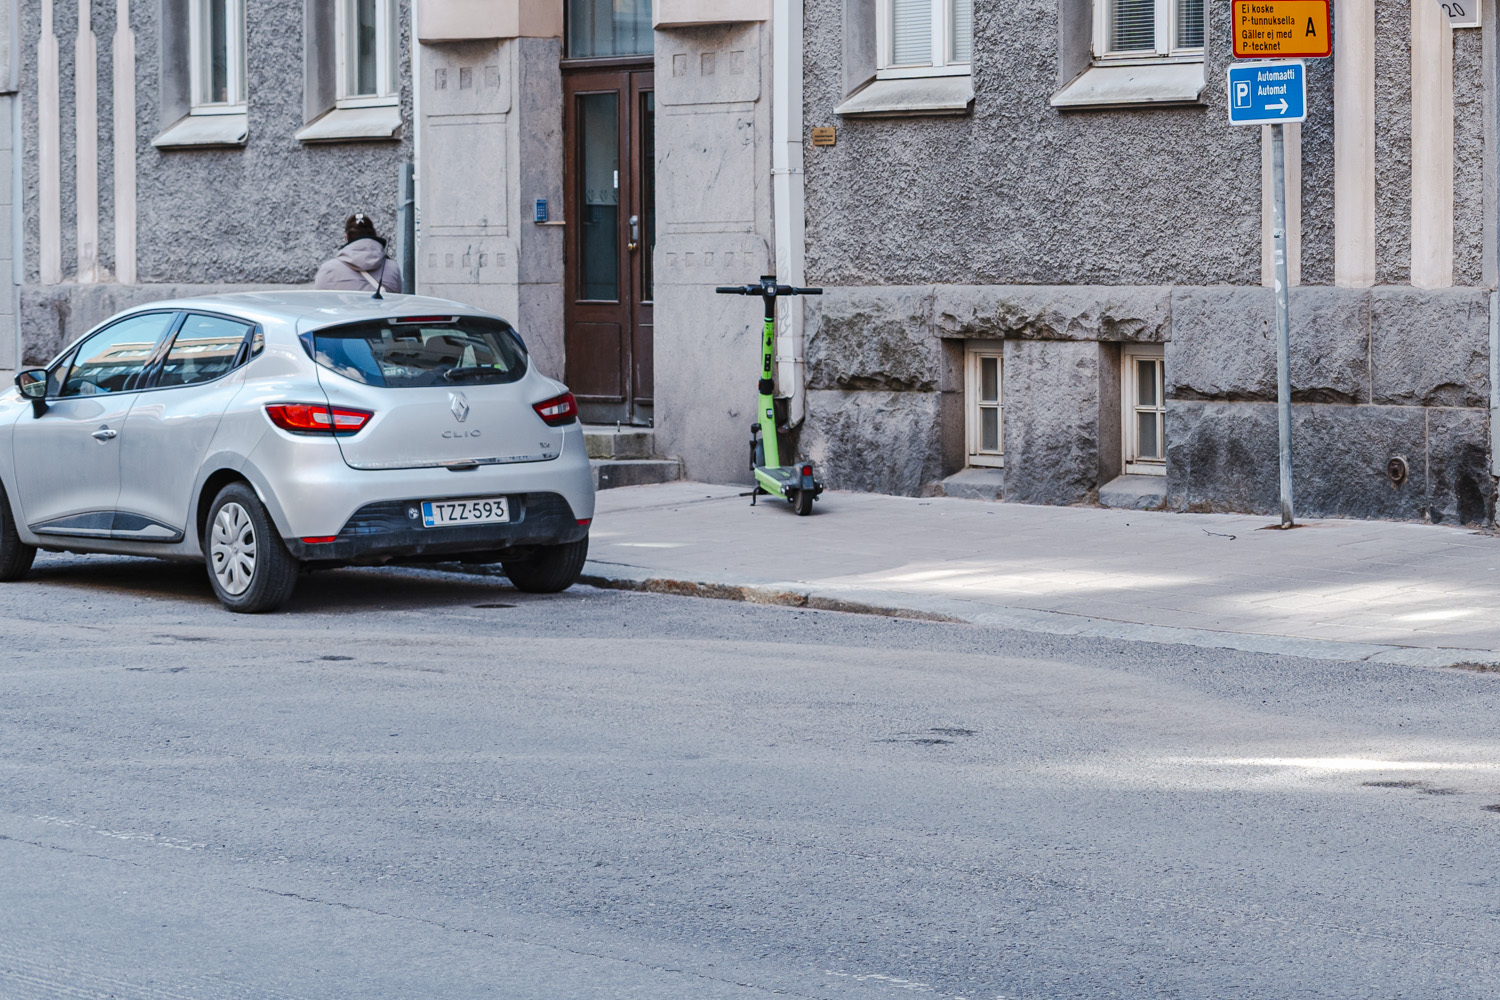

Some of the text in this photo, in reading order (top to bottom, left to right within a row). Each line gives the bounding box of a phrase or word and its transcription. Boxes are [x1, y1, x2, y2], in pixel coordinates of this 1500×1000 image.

[1241, 3, 1274, 13] Ei koske
[1442, 2, 1466, 18] 20
[1241, 16, 1295, 26] P-tunnuksella
[1305, 16, 1317, 37] A
[1241, 29, 1293, 40] Gäller ej med
[1242, 41, 1281, 51] P-tecknet
[1257, 69, 1295, 82] Automaatti
[1236, 83, 1249, 106] P
[1257, 83, 1287, 96] Automat
[441, 429, 481, 439] CLIO
[435, 501, 505, 522] TZZ-593
